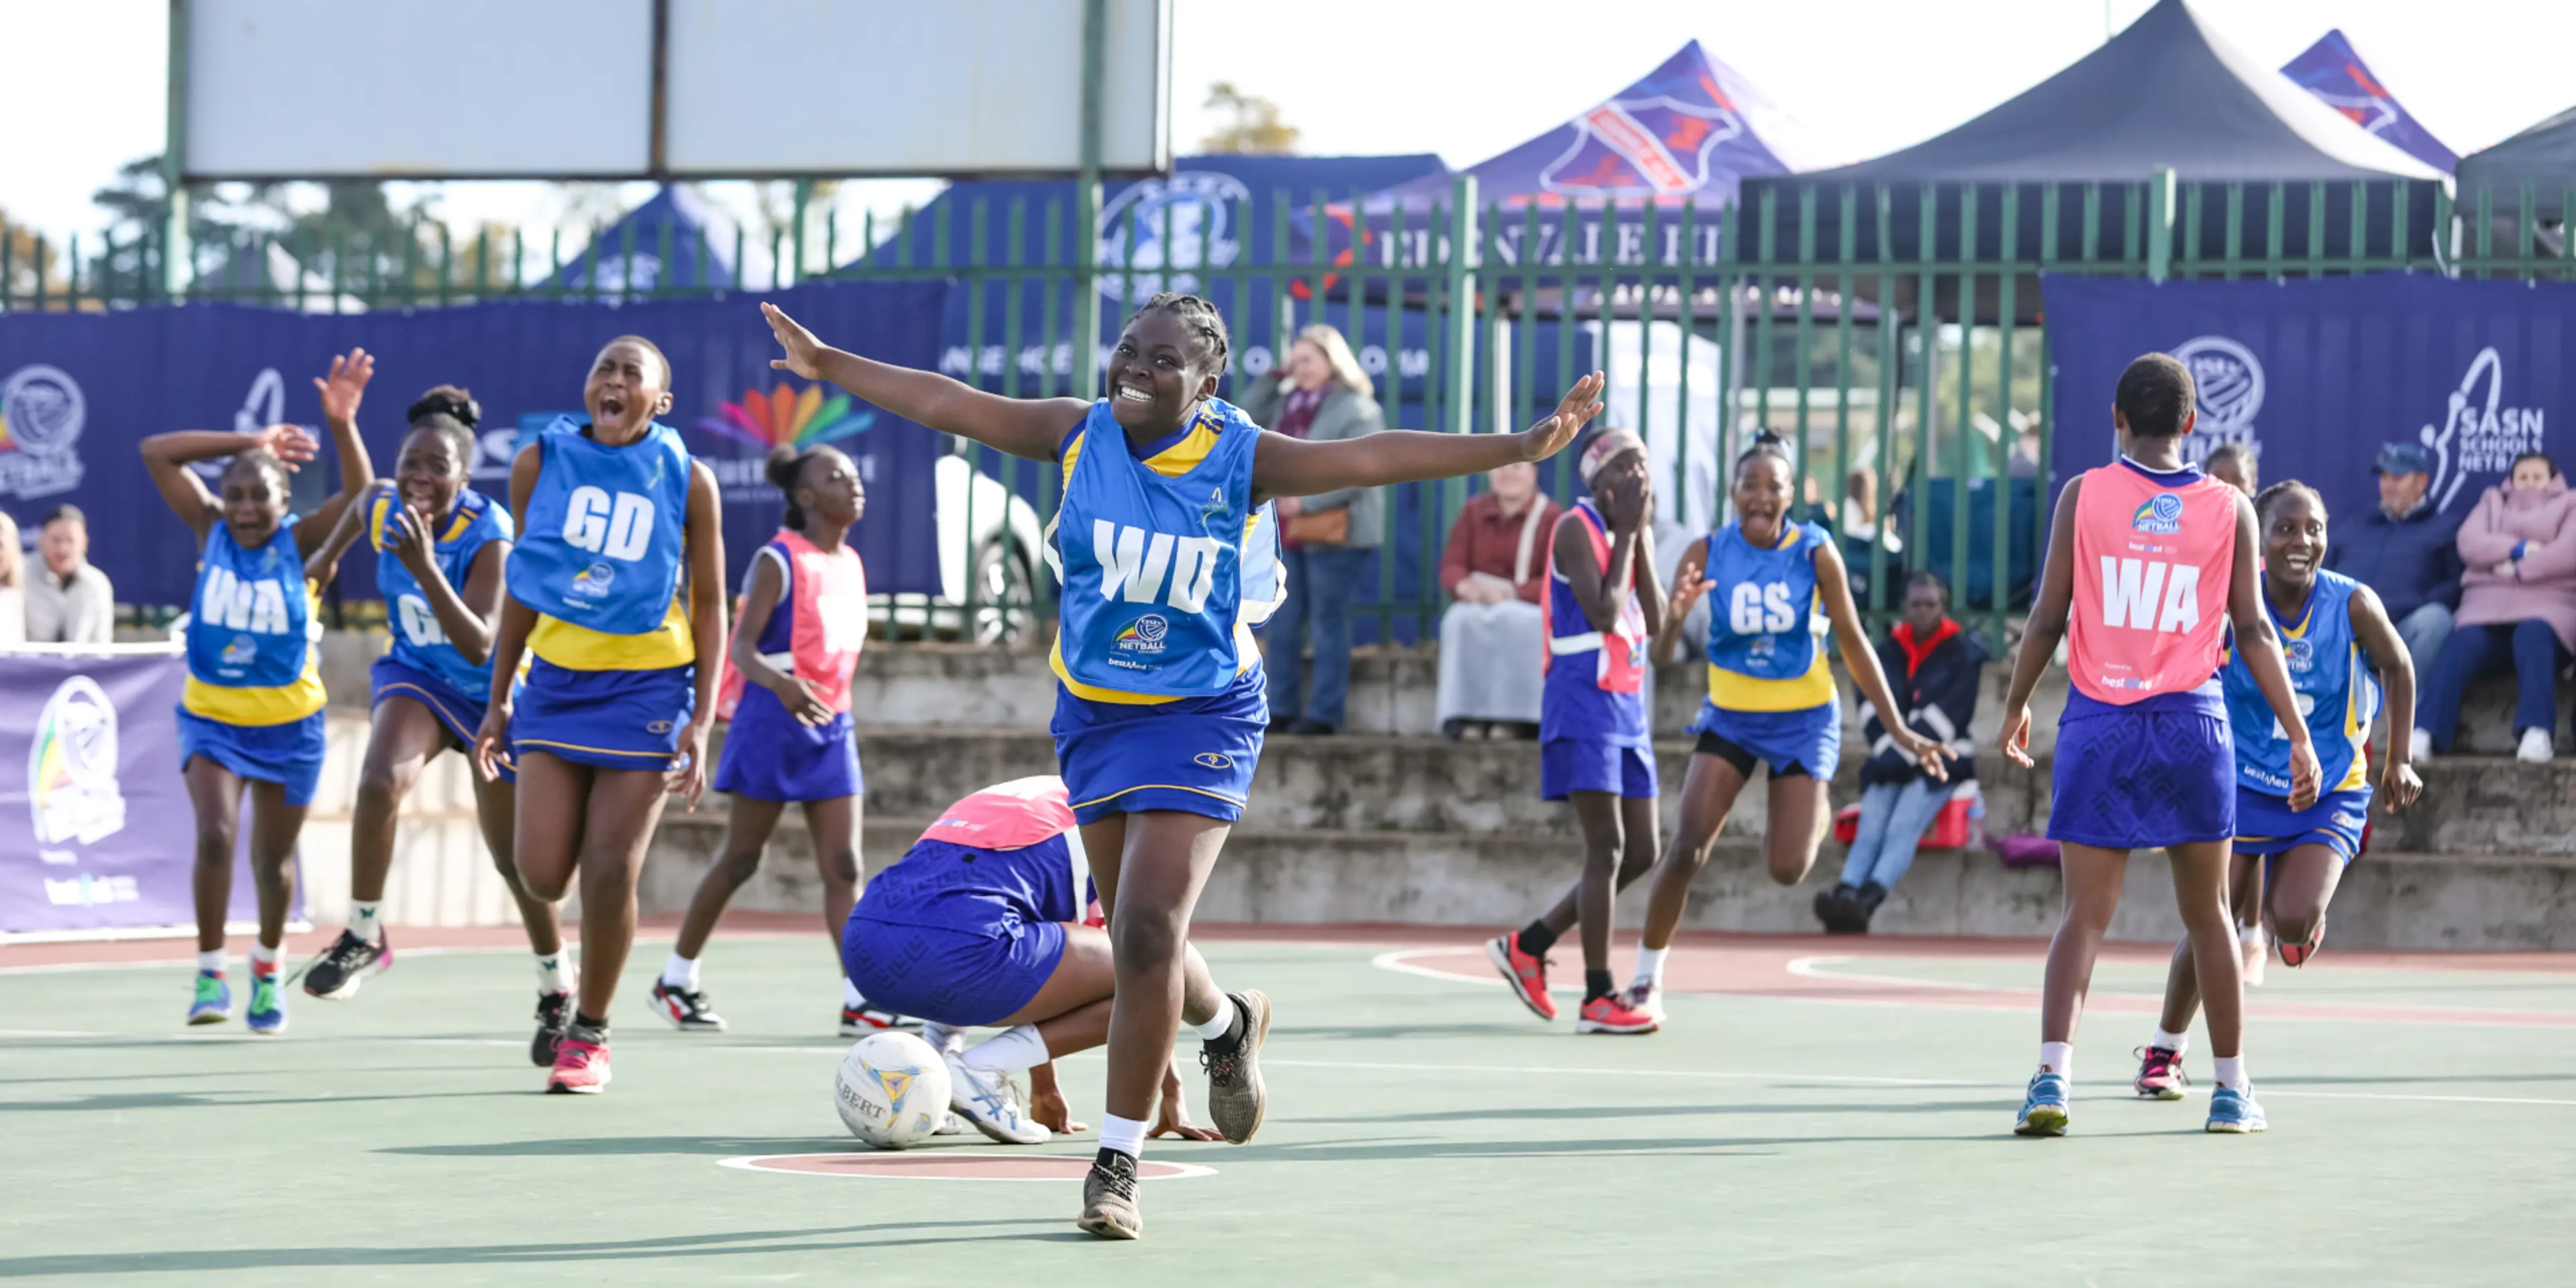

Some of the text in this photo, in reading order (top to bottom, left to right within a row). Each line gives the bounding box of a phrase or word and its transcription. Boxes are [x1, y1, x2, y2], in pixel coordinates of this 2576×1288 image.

[2460, 407, 2543, 437] SASN
[563, 486, 655, 561] GD
[202, 565, 290, 635] WA
[398, 593, 452, 647] G
[1730, 581, 1795, 635] GS
[2100, 555, 2200, 635] WA
[1120, 641, 1165, 650] NETBALL
[836, 1073, 884, 1119] LBERT
